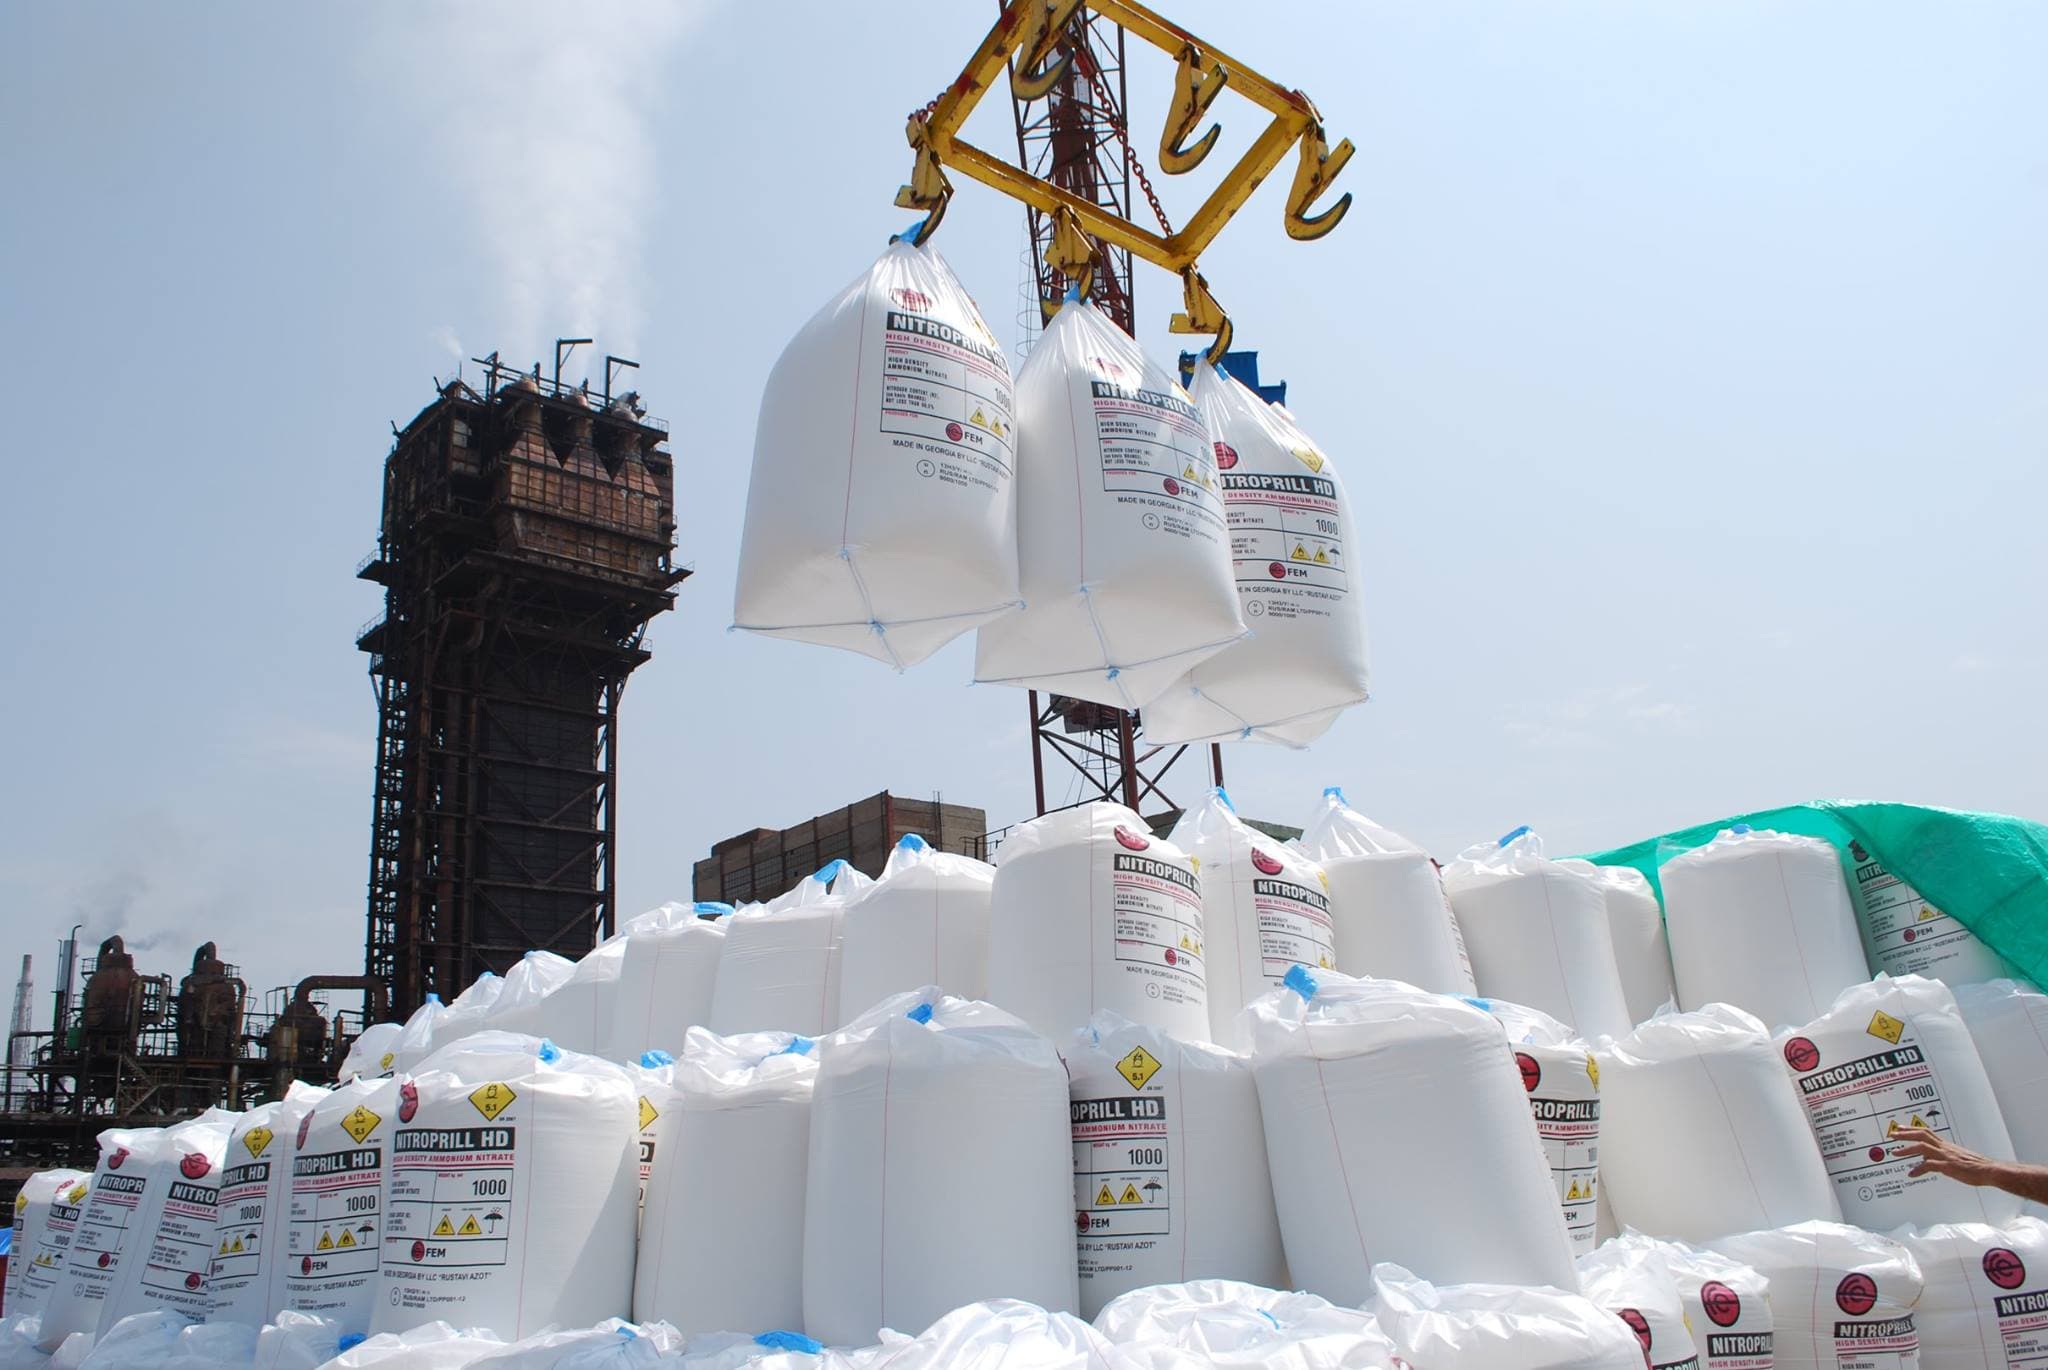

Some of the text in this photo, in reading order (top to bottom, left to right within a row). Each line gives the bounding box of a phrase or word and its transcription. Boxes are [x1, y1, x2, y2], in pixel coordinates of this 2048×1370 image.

[886, 332, 910, 343] HIGH
[913, 336, 951, 353] DENSITY
[905, 357, 928, 368] DENSITY
[887, 364, 948, 380] AMMONIUM NITRATE
[1093, 400, 1116, 408] HIGH
[1119, 401, 1153, 413] DENSITY
[964, 431, 983, 445] FEM
[892, 439, 914, 449] MADE
[924, 444, 956, 458] GEORGIA
[1180, 486, 1198, 499] FEM
[1220, 475, 1333, 496] ITROPRILL HD
[1147, 499, 1176, 510] GEORGIA
[1265, 493, 1312, 504] AMMONIUM
[1313, 499, 1338, 510] NITRATE
[1316, 519, 1338, 535] 1000
[1287, 568, 1308, 578] FEM
[1253, 586, 1281, 594] GEORGIA
[1119, 856, 1192, 887] NITROPRILL
[1858, 863, 1883, 880] NITR
[1135, 876, 1164, 887] DENSITY
[1258, 881, 1326, 909] NITROPRILL
[1916, 926, 1933, 936] FEM
[1177, 956, 1190, 966] FEM
[1126, 965, 1142, 974] MADE
[1151, 969, 1173, 980] GEORGIA
[1132, 1072, 1144, 1080] 5.1
[1803, 1049, 1918, 1091] NITROPRILL HD
[1822, 1085, 1850, 1097] DENSITY
[1853, 1072, 1897, 1089] AMMONIUM
[1898, 1064, 1929, 1077] NITRATE
[1905, 1083, 1935, 1101] 1000
[485, 1103, 497, 1112] 5.1
[1072, 1099, 1159, 1120] OPRILL HD
[1532, 1101, 1591, 1119] ROPRILL
[1081, 1123, 1125, 1133] AMMONIUM
[1128, 1122, 1167, 1131] NITRATE
[396, 1130, 509, 1149] NITROPRILL HD
[296, 1151, 376, 1174] TROPRILL HD
[404, 1155, 427, 1163] DENSITY
[428, 1154, 473, 1163] AMMONIUM
[475, 1153, 514, 1161] NITRATE
[1128, 1148, 1163, 1165] 1000
[248, 1165, 266, 1180] HD
[348, 1172, 381, 1180] NITRATE
[1859, 1170, 1884, 1180] GEORGIA
[1884, 1167, 1894, 1175] BY
[1895, 1164, 1906, 1172] LLC
[100, 1175, 144, 1192] NITROPR
[472, 1178, 507, 1196] 1000
[172, 1184, 216, 1204] NITRO
[182, 1203, 211, 1214] DENSITY
[346, 1194, 376, 1211] 1000
[64, 1211, 79, 1220] HD
[240, 1205, 262, 1220] 1000
[1091, 1218, 1110, 1228] FEM
[425, 1248, 446, 1258] FEM
[1093, 1243, 1104, 1251] LLC
[1104, 1242, 1134, 1251] "RUSTAVI
[1135, 1241, 1156, 1249] AZOT"
[311, 1261, 328, 1271] FEM
[425, 1272, 437, 1280] LLC
[438, 1272, 468, 1281] "RUSTAVI
[469, 1271, 492, 1280] AZOT"
[1999, 1315, 2048, 1327] HIGH DENSITY
[1836, 1338, 1886, 1347] HIGH DENSITY
[1709, 1360, 1728, 1368] HIGH
